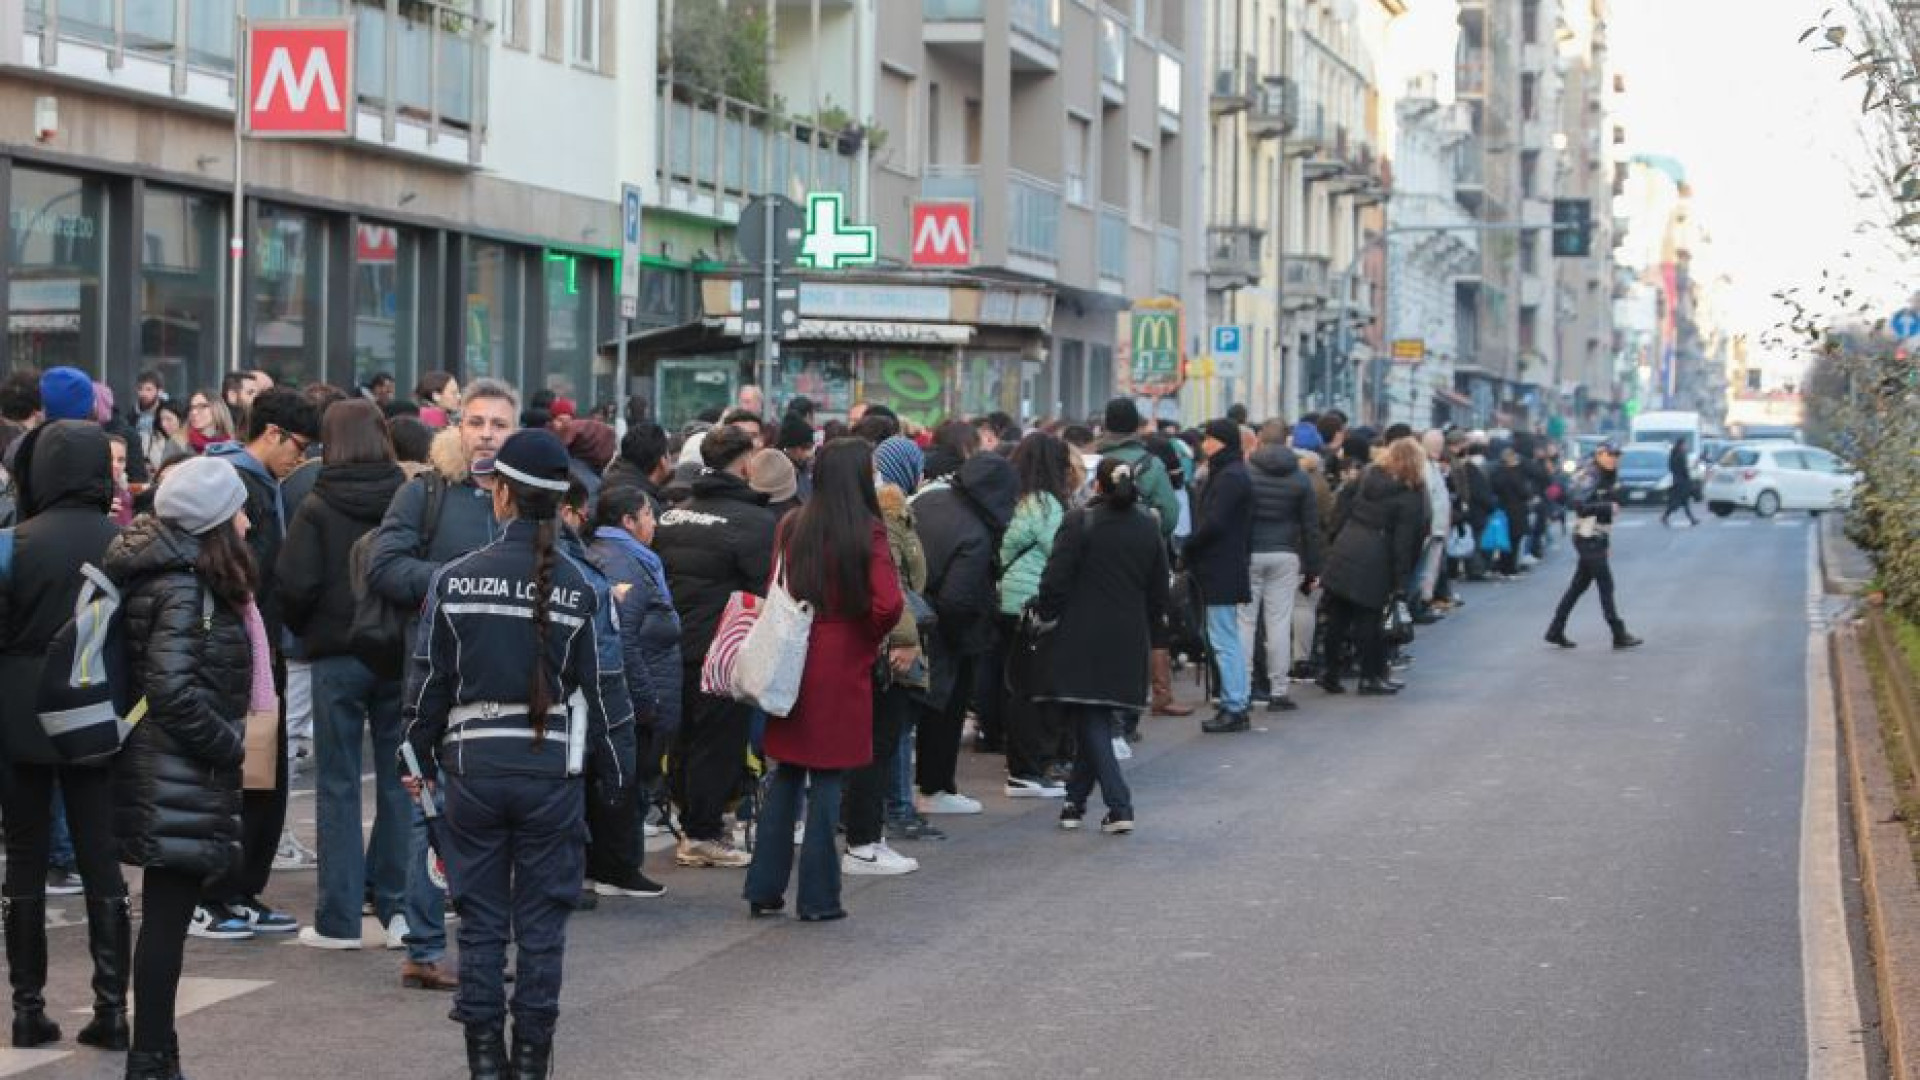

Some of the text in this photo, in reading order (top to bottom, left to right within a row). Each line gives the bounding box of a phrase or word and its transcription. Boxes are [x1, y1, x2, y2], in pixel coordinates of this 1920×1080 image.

[254, 46, 341, 112] M
[628, 197, 638, 238] P
[915, 215, 966, 254] M
[1220, 330, 1236, 349] P
[448, 577, 582, 608] POLIZIA LOALE
